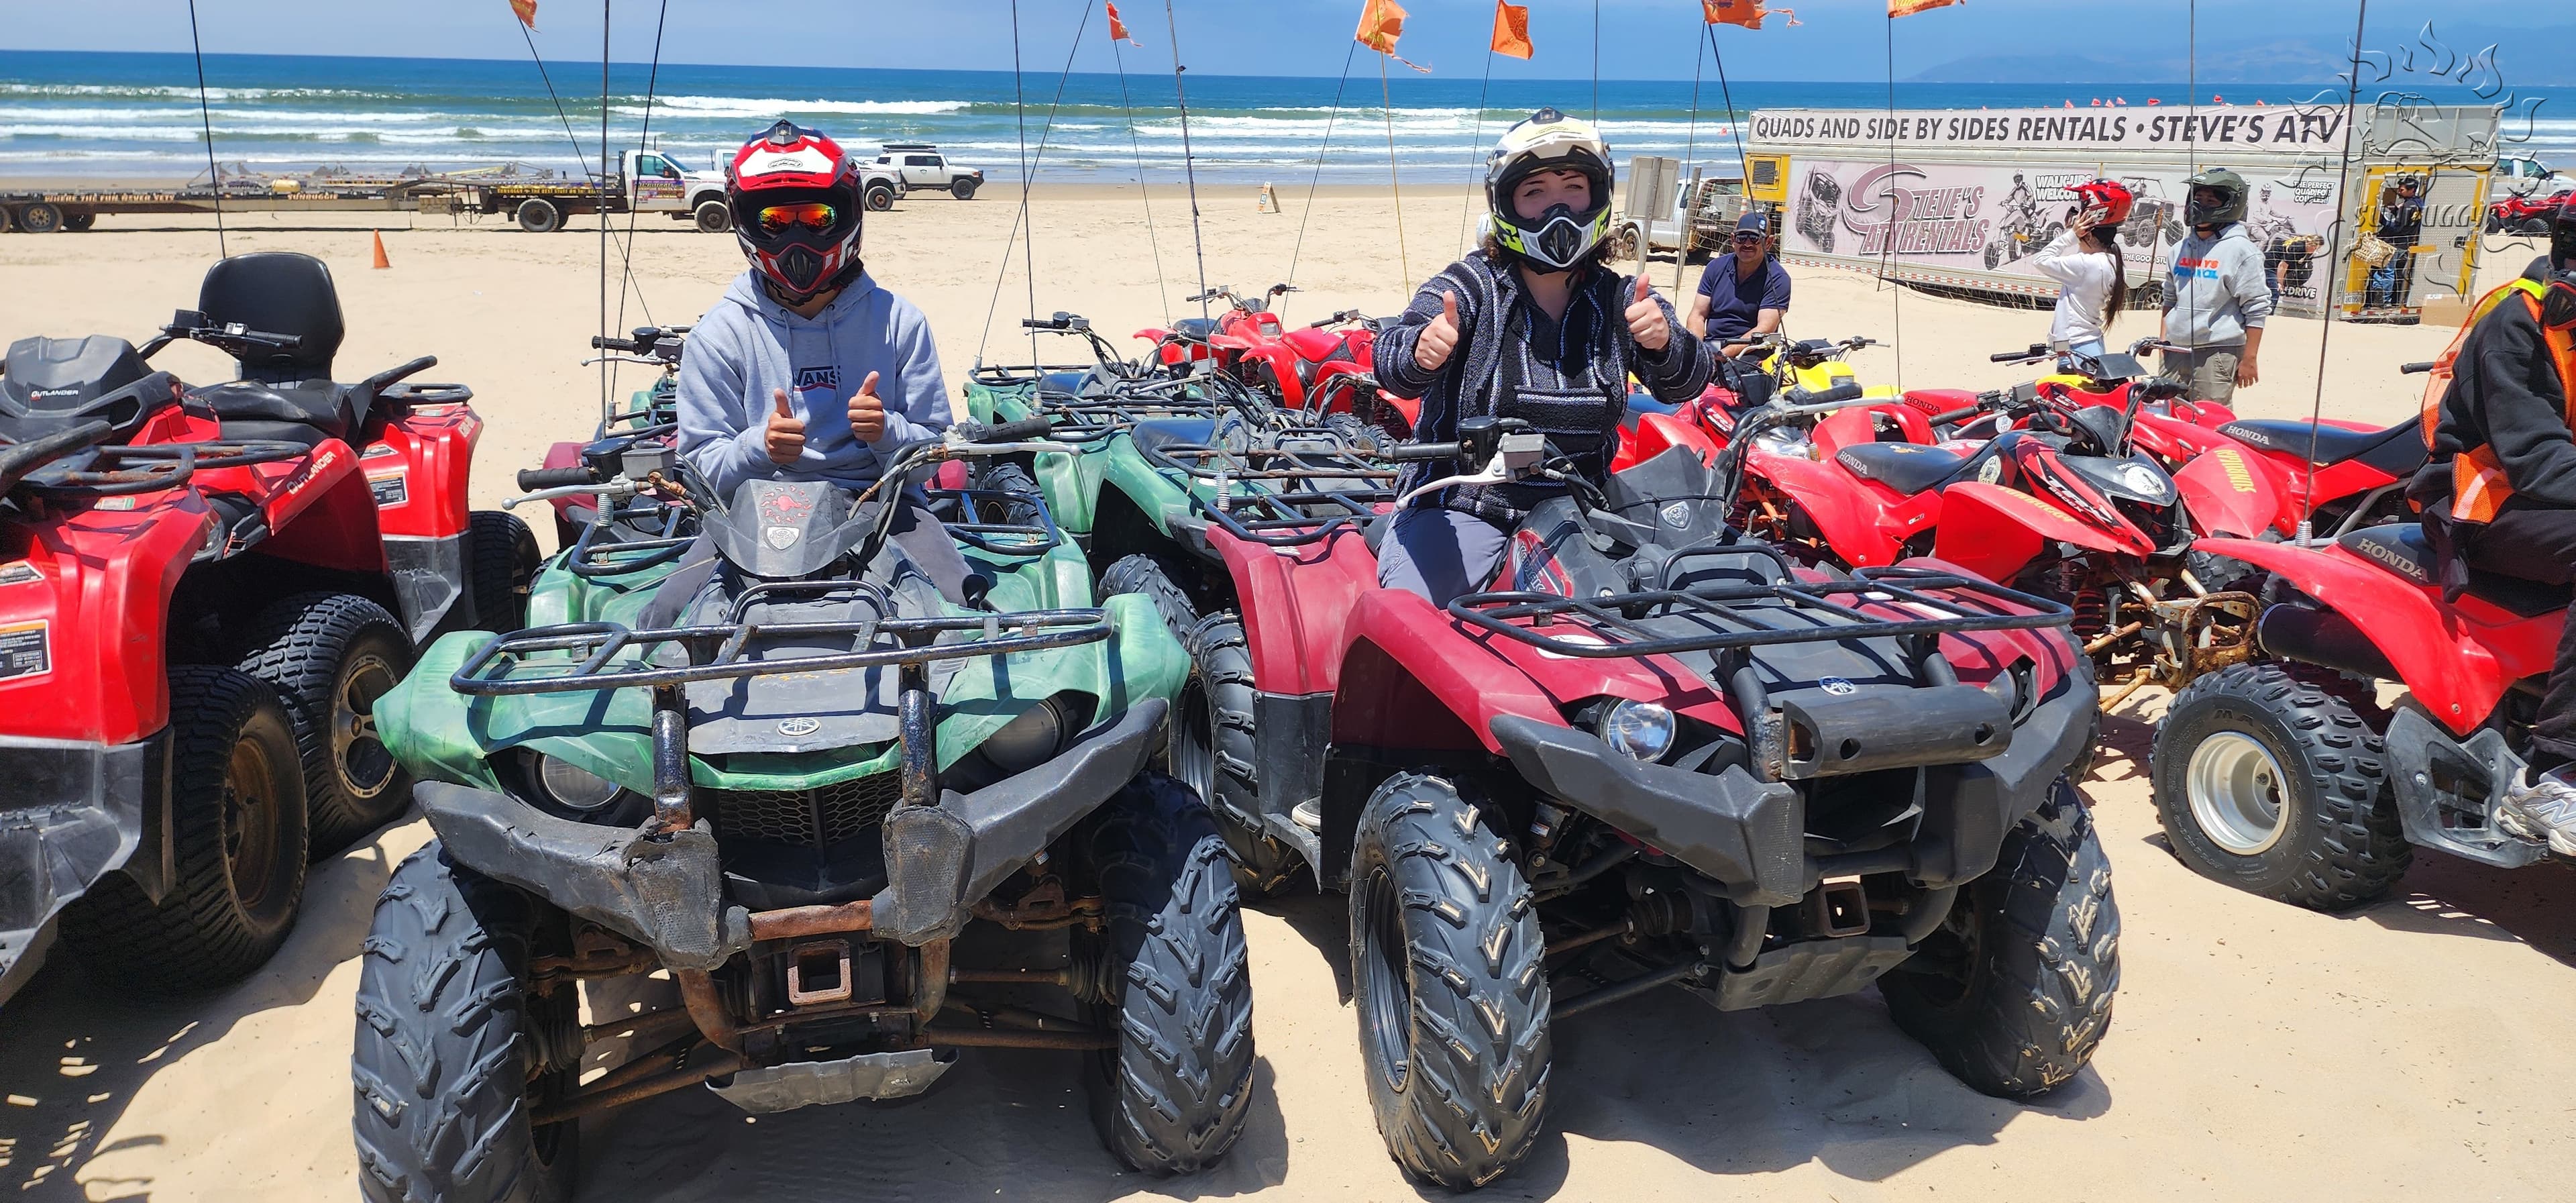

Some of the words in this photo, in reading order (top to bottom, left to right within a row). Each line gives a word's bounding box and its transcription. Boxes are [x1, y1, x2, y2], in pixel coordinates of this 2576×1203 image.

[1756, 117, 1815, 140] QUADS
[1819, 118, 1860, 139] AND
[1866, 118, 1909, 140] SIDE
[1915, 118, 1943, 140] BY
[1947, 117, 2010, 141] SIDES
[2017, 116, 2127, 142] RENTALS
[2149, 115, 2265, 144] STEVE'S
[2272, 115, 2343, 144] ATV
[1842, 163, 1985, 234] STEVE'S
[2295, 188, 2316, 196] QUAD
[1860, 221, 1904, 255] ATV
[1899, 218, 1990, 254] RENTALS
[2123, 253, 2135, 262] THE
[792, 366, 841, 386] VANS
[31, 390, 79, 398] OUTLANDER
[1905, 395, 1941, 414] HONDA
[2226, 425, 2270, 446] HONDA
[286, 450, 337, 495] OUTLANDER
[1839, 450, 1868, 475] HONDA
[2356, 537, 2430, 583] HONDA
